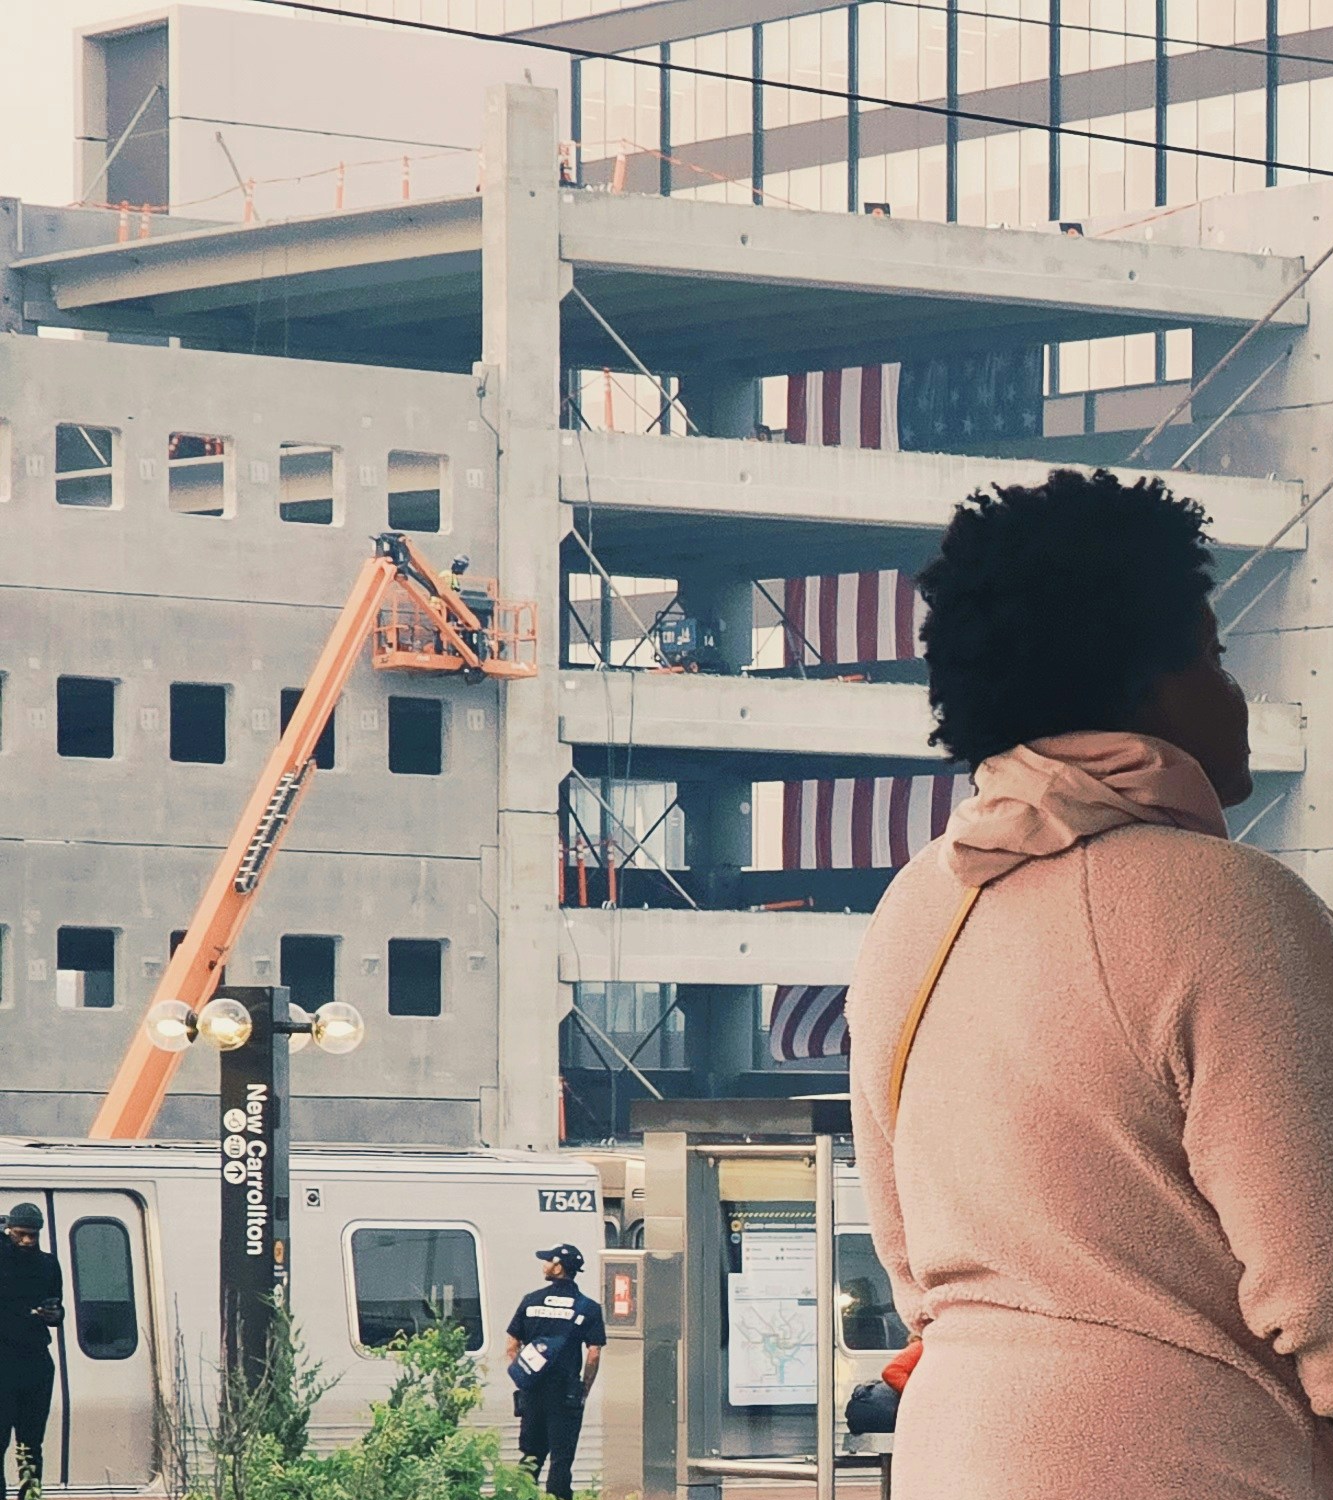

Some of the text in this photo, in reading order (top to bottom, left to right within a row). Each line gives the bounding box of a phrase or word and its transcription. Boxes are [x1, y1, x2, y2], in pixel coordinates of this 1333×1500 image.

[246, 1083, 269, 1256] New Carrollton
[541, 1191, 593, 1211] 7542
